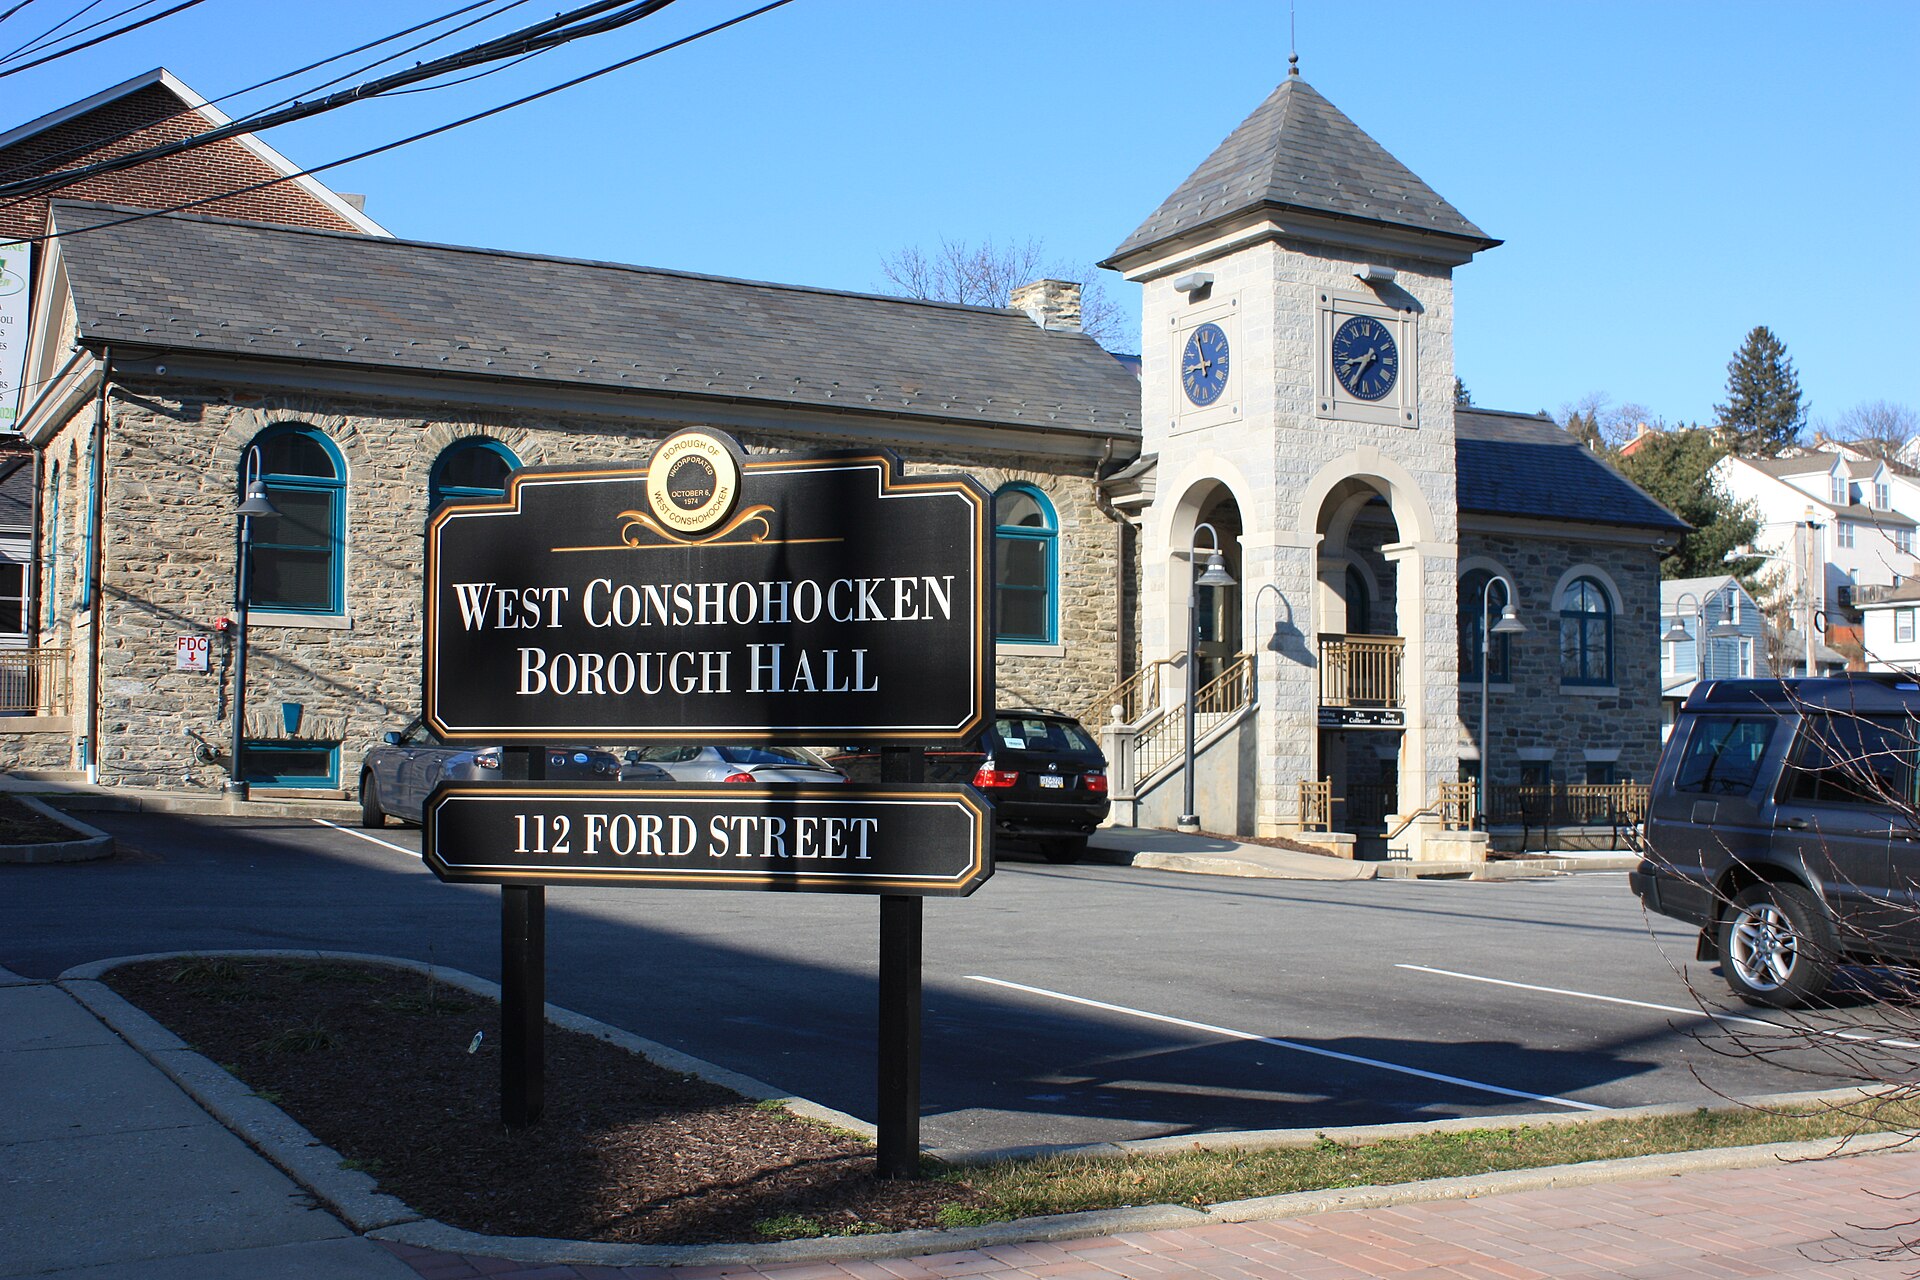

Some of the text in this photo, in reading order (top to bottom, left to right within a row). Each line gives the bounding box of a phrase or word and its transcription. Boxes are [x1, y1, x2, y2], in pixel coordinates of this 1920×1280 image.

[662, 440, 720, 460] BOROUGH OF
[669, 456, 713, 477] INCORPORATED
[654, 486, 728, 525] WEST CONSHOHOCKEN
[671, 489, 703, 497] OCTOBER
[453, 575, 955, 632] WEST CONSHOHOCKEN
[178, 637, 207, 651] FDC
[516, 643, 878, 696] BOROUGH HALL
[514, 813, 878, 861] 112 FORD STREET
